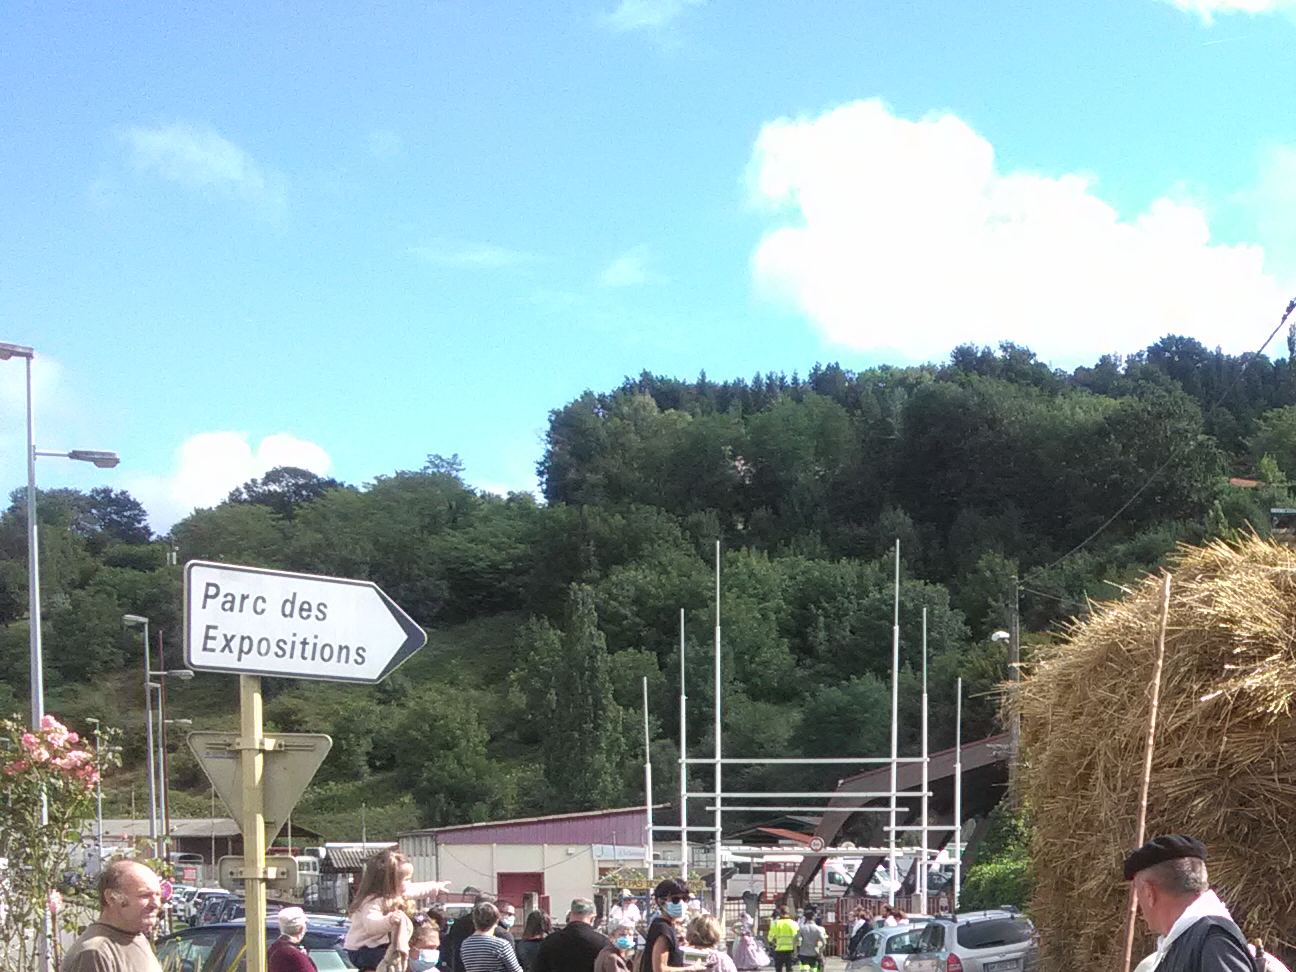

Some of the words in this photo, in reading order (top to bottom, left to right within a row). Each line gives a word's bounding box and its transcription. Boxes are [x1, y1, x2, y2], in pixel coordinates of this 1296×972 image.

[201, 582, 267, 616] Parc
[281, 592, 328, 621] des
[201, 625, 367, 666] Expositions
